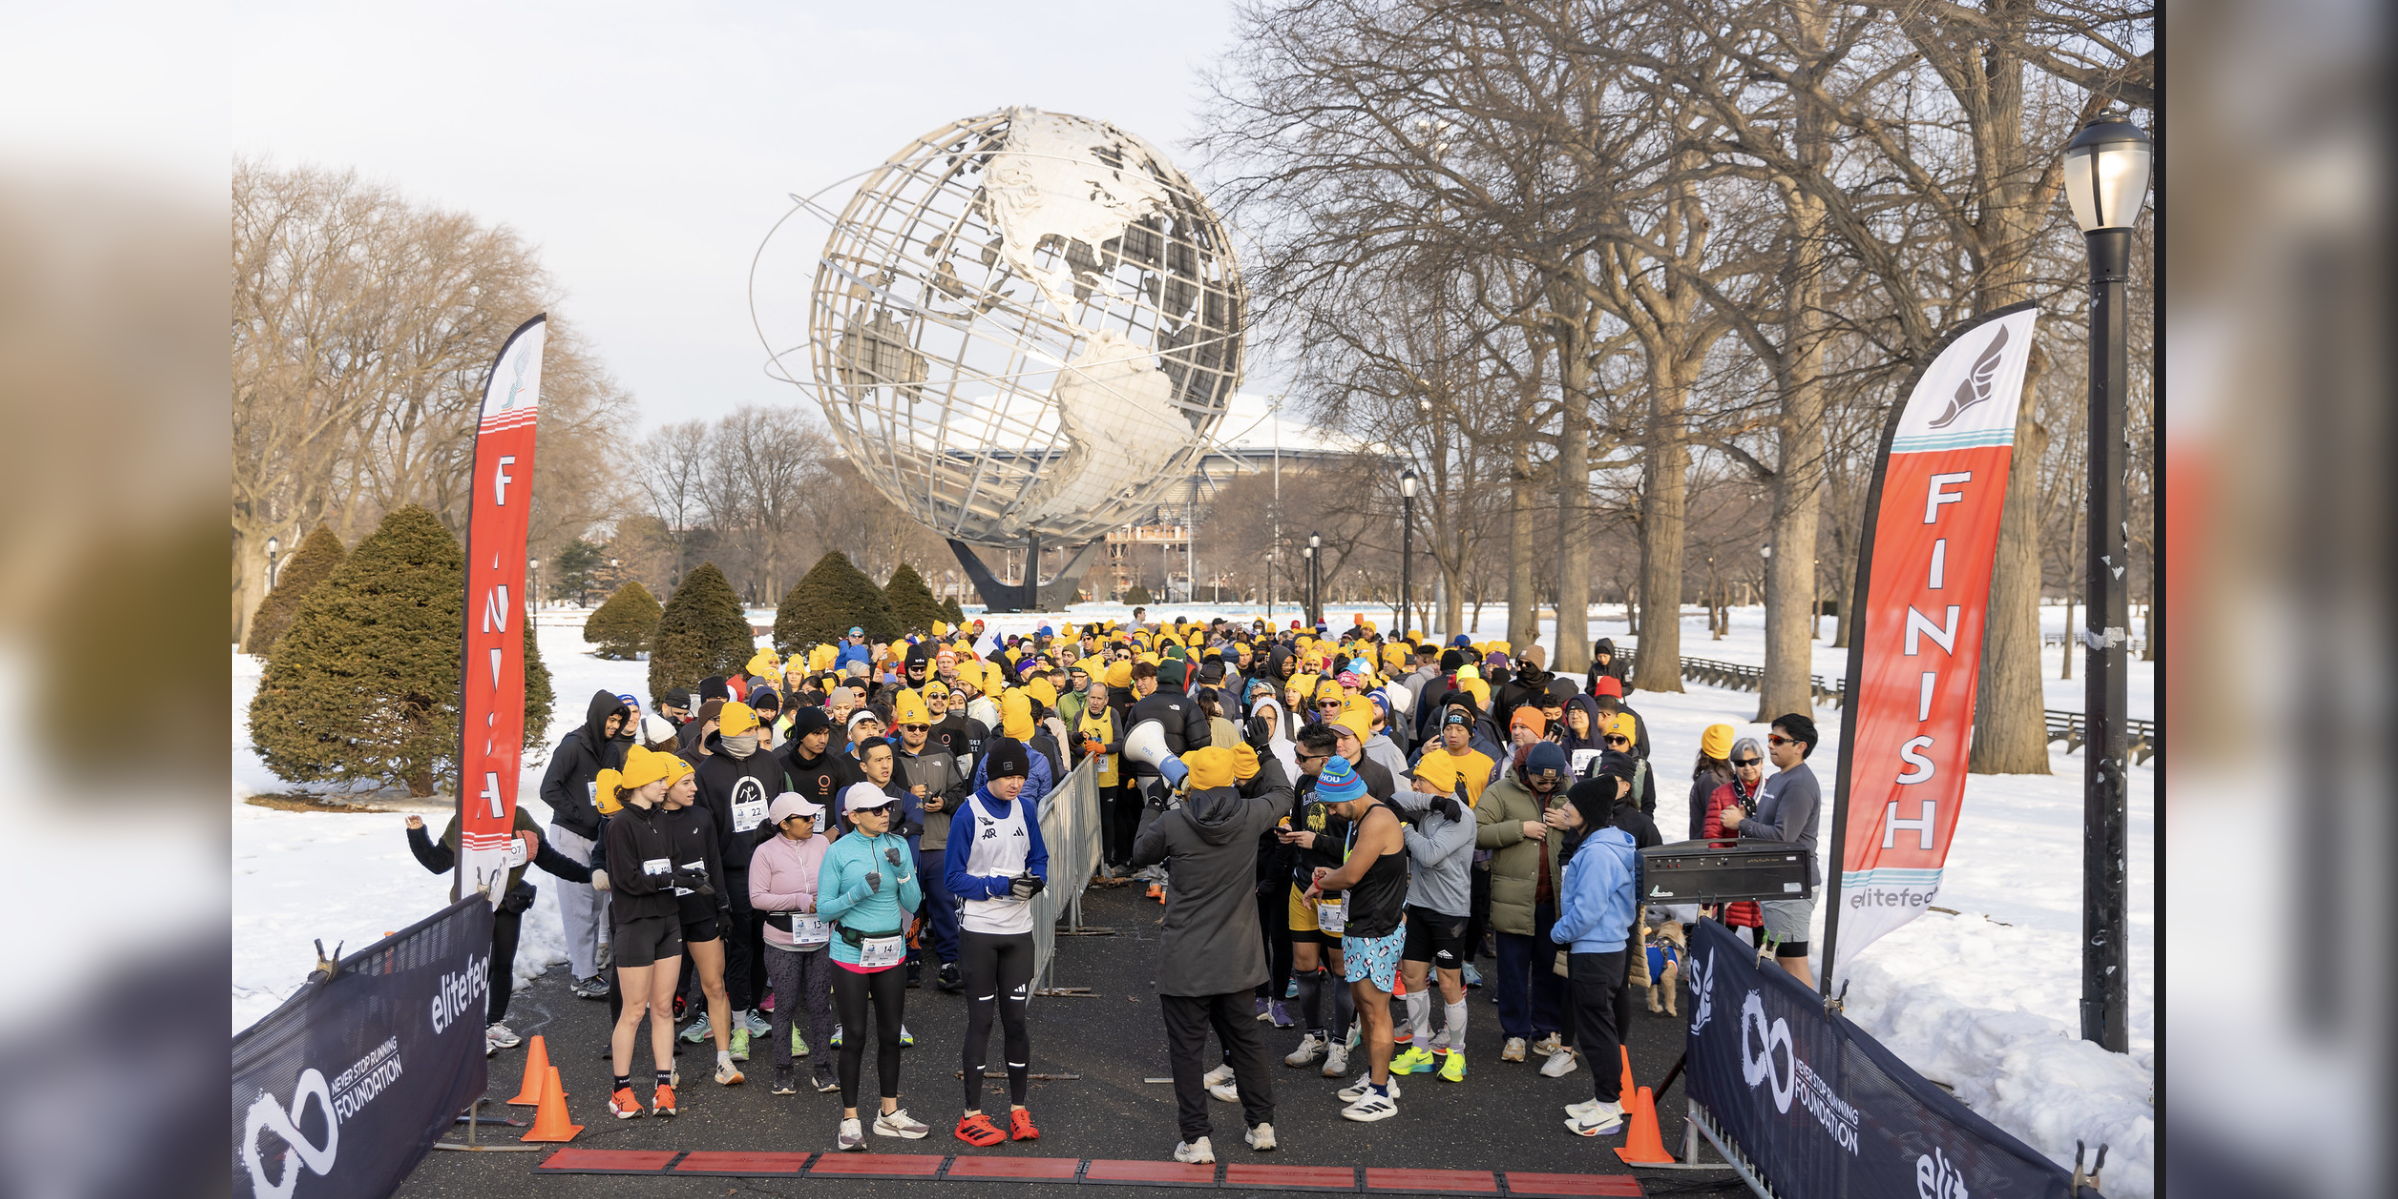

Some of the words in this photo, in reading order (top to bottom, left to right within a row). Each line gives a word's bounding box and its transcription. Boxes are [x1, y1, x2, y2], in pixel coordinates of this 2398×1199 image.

[1881, 471, 1972, 850] FINISH
[751, 807, 762, 817] 22
[813, 920, 822, 929] 13
[883, 944, 893, 953] 14
[331, 1068, 354, 1096] NEVER
[353, 1055, 370, 1079] STOP
[369, 1035, 398, 1067] RUNNING
[334, 1053, 403, 1125] FOUNDATION
[1795, 1056, 1813, 1084] NEVER
[1812, 1073, 1827, 1096] STOP
[1826, 1087, 1859, 1126] RUNNING
[1795, 1076, 1859, 1157] FOUNDATION
